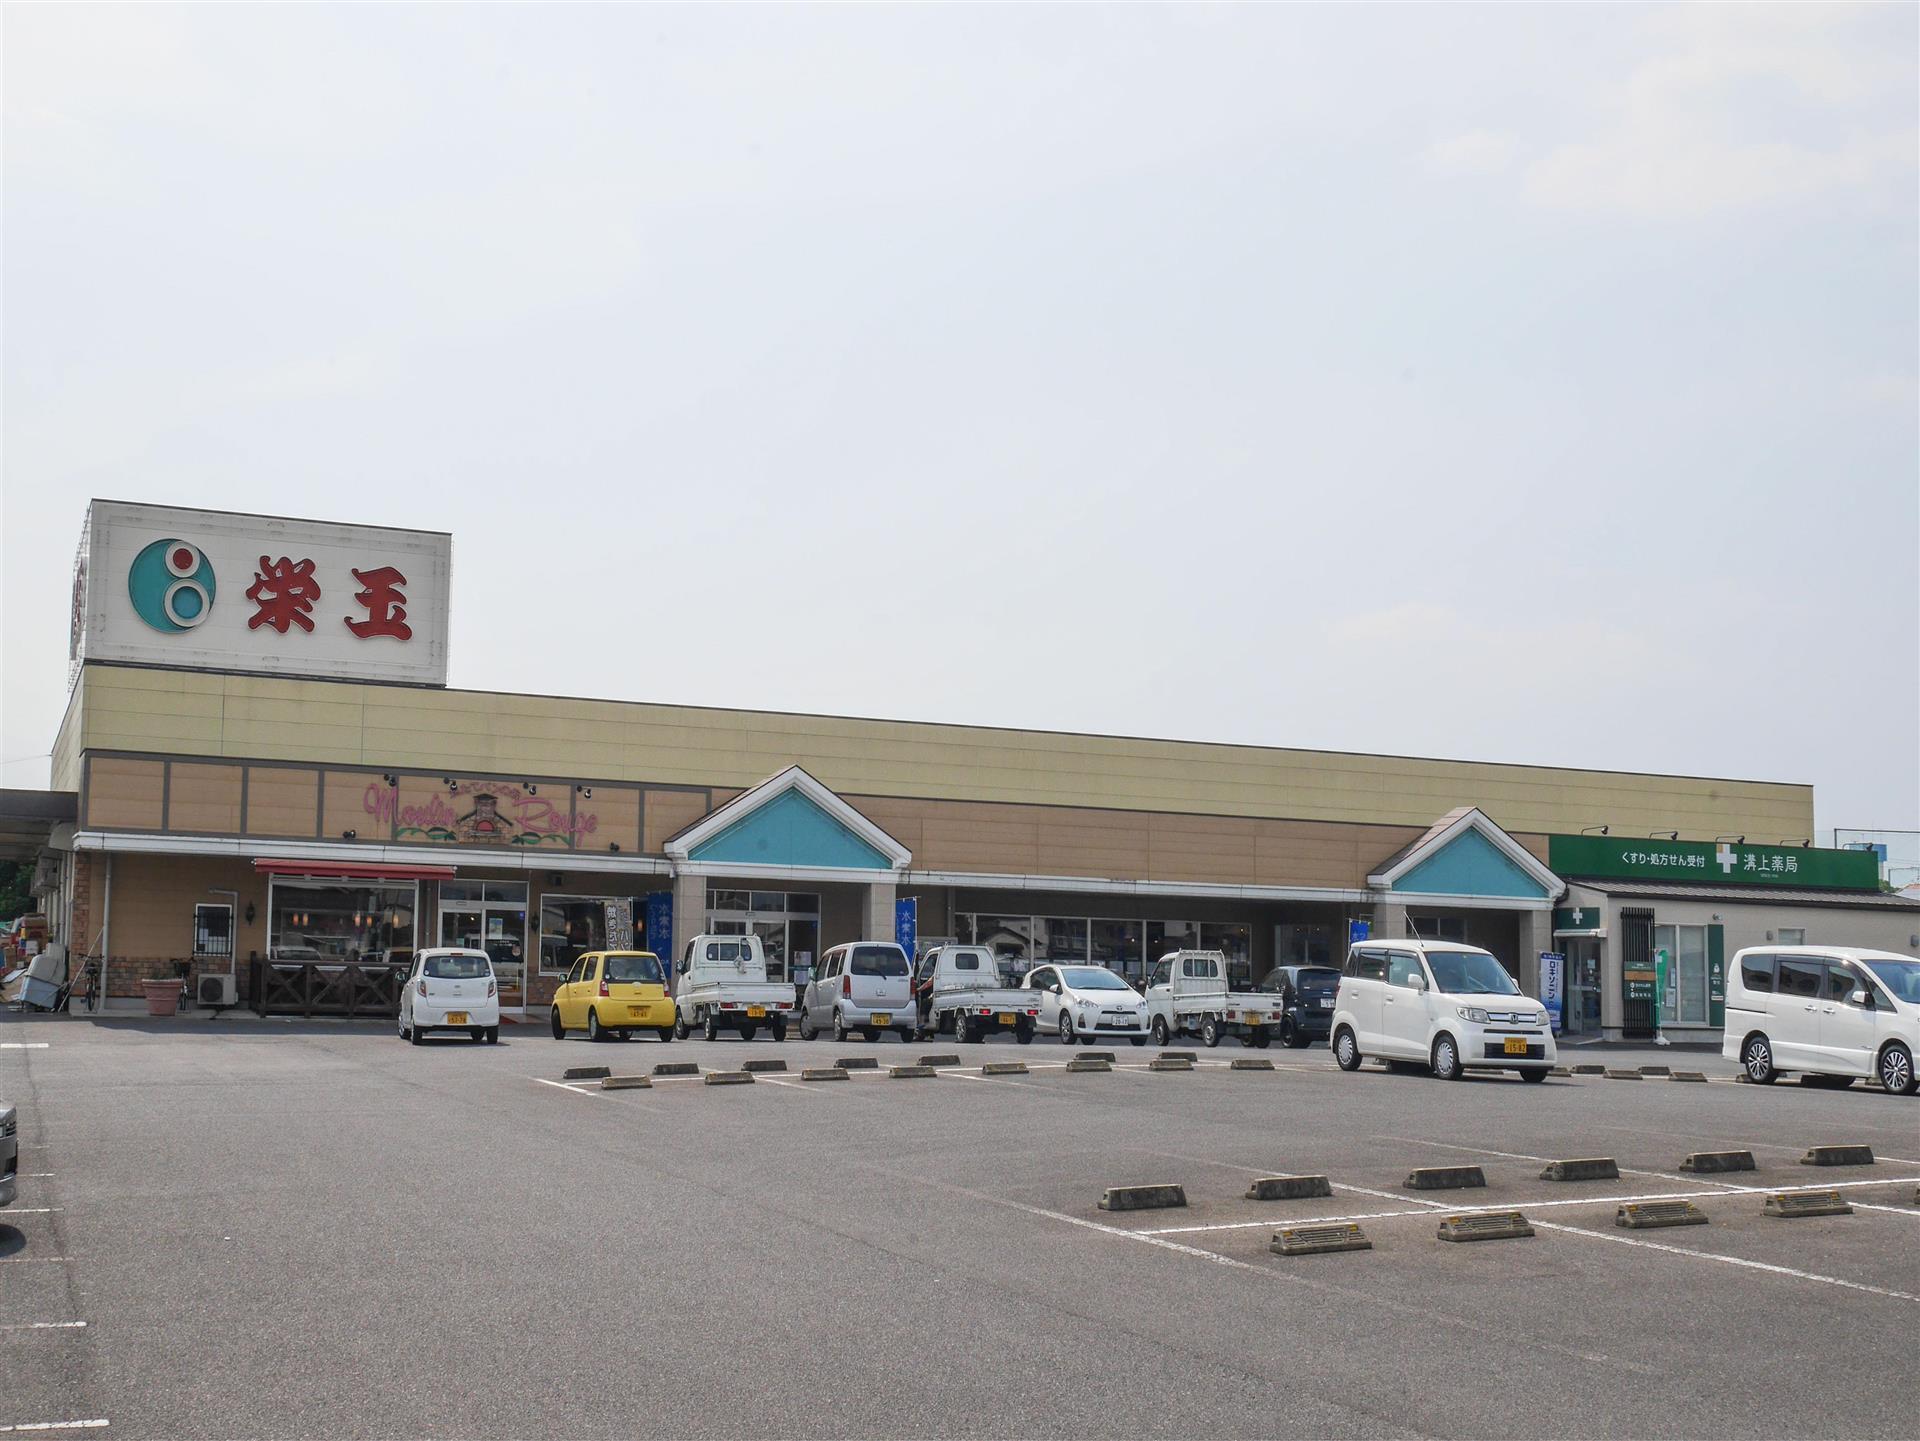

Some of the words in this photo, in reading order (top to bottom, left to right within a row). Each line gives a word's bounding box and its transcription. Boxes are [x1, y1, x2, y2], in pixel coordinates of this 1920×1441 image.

[245, 555, 413, 641] 栄玉
[363, 783, 458, 826] Moulin
[512, 797, 598, 847] Rouge
[1621, 851, 1705, 868] くすり・処方せん受付
[1743, 854, 1798, 873] 溝上薬局
